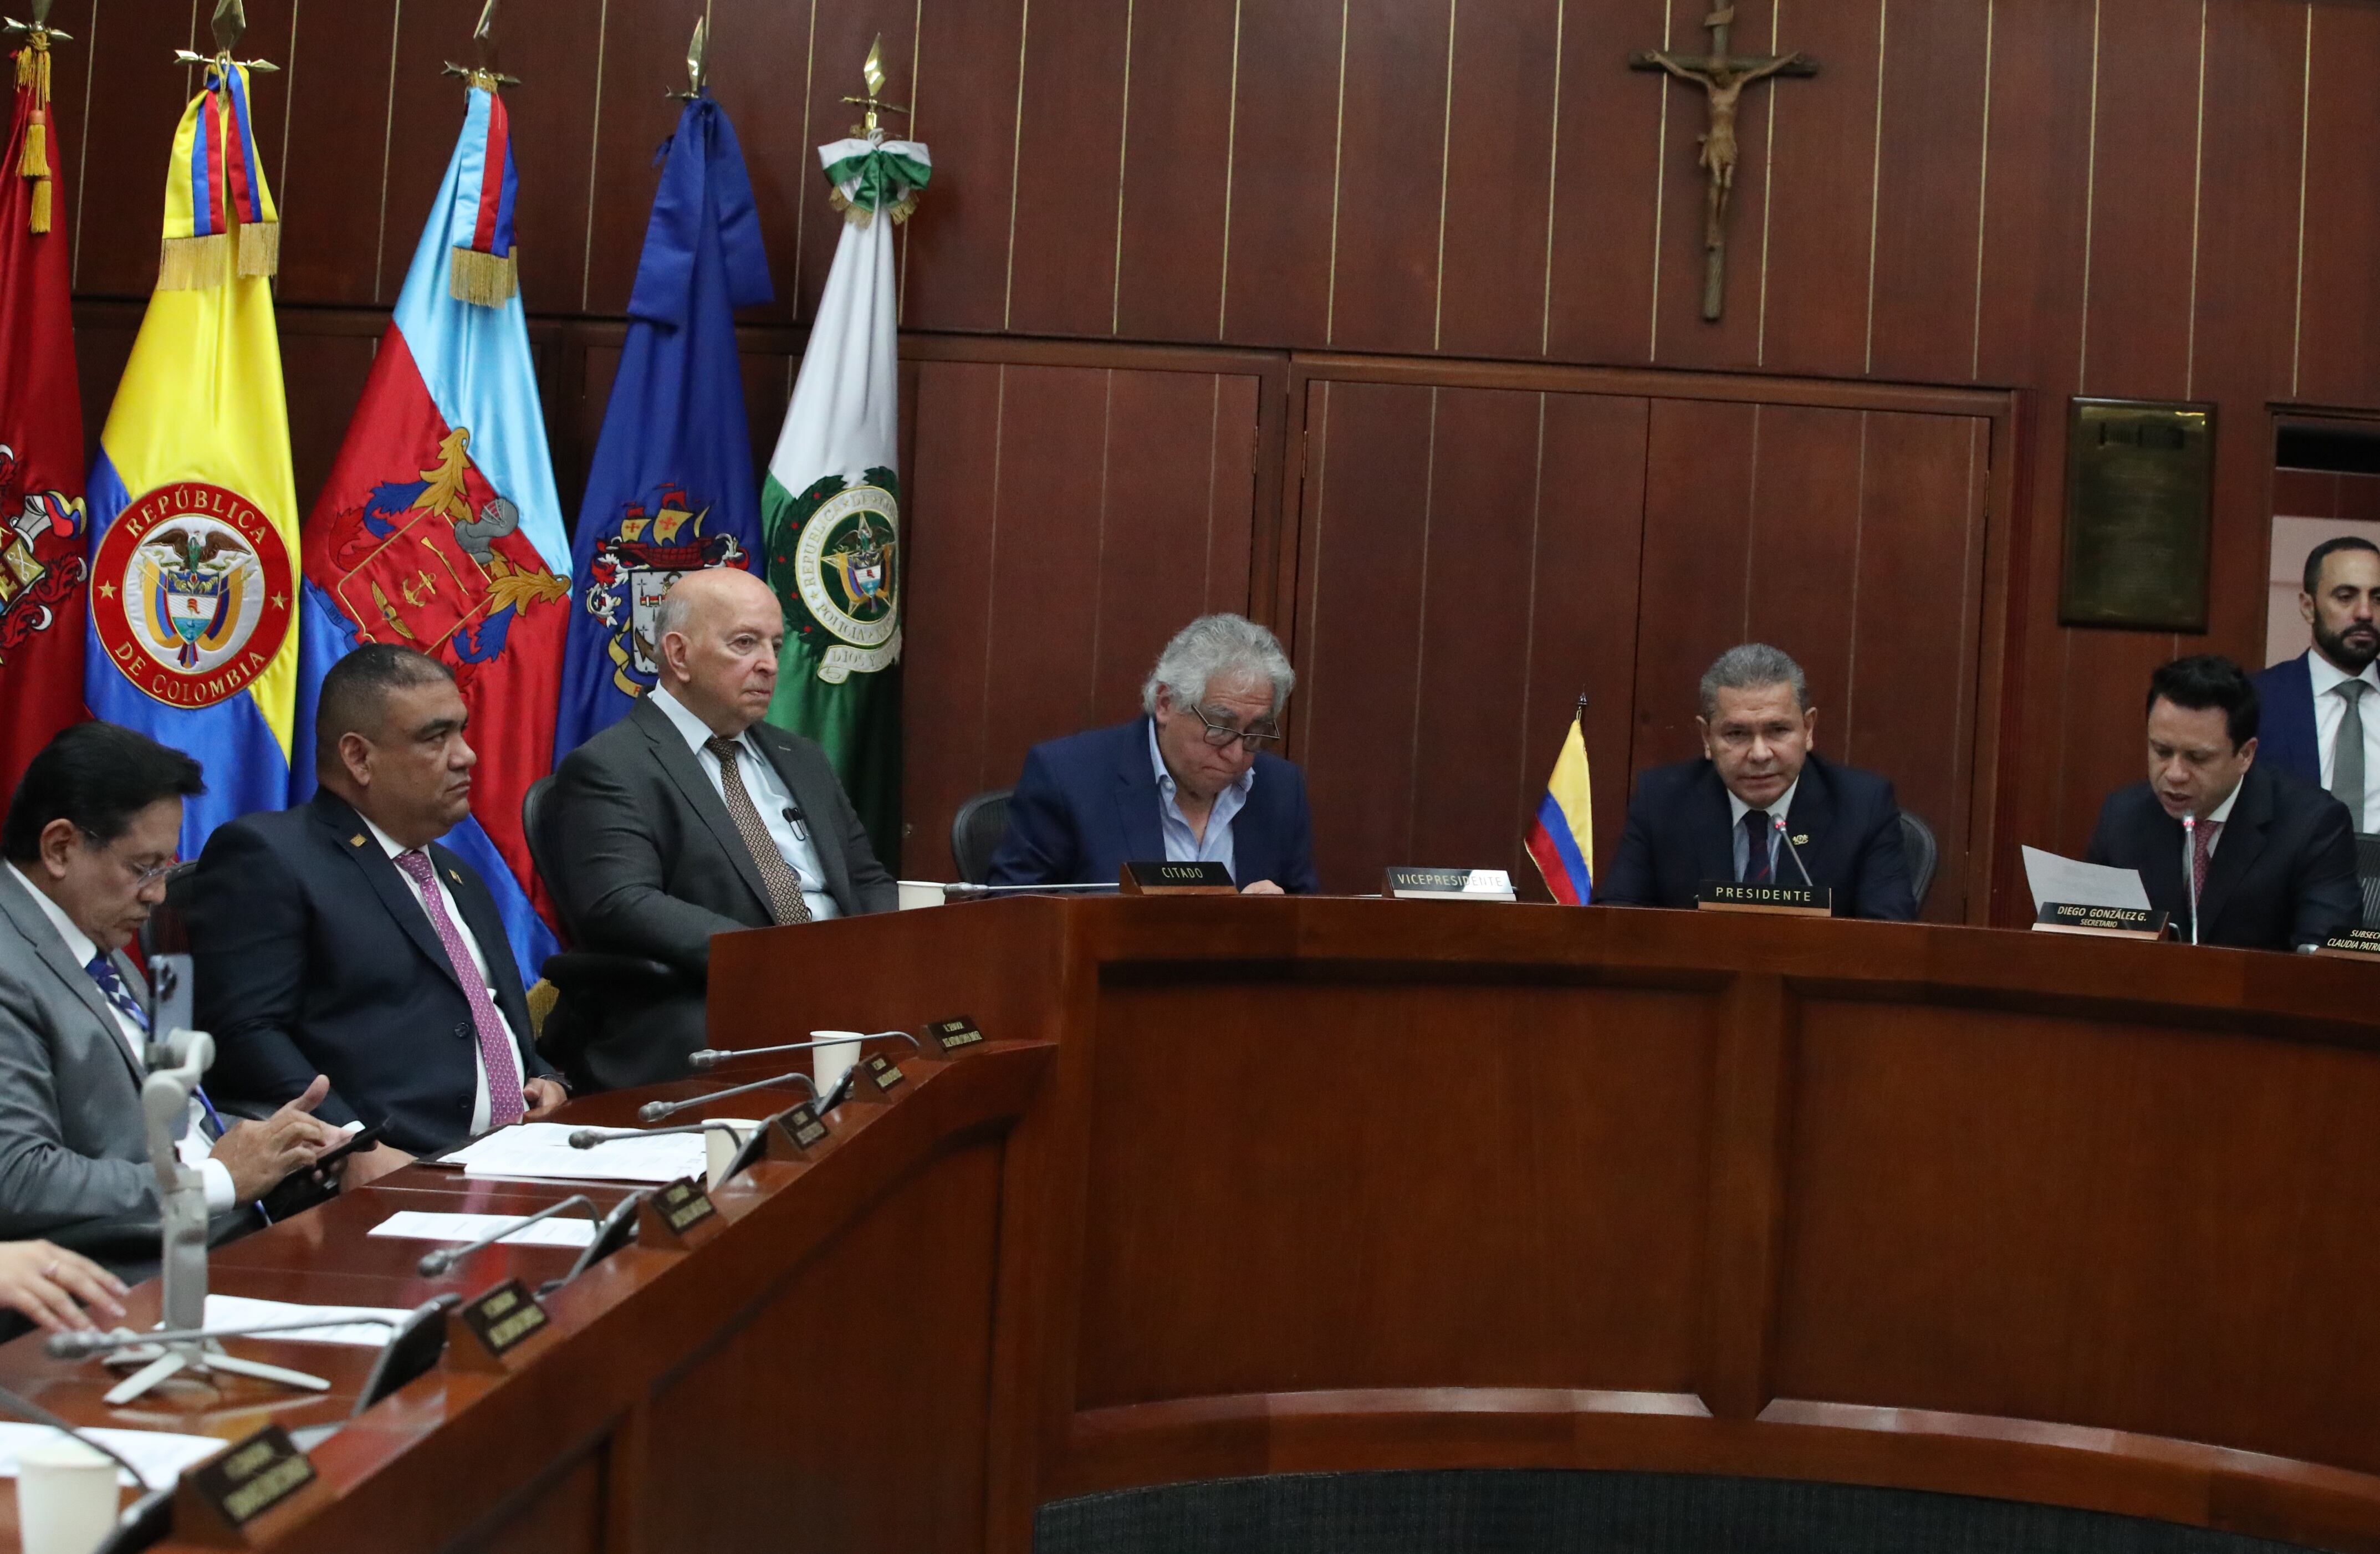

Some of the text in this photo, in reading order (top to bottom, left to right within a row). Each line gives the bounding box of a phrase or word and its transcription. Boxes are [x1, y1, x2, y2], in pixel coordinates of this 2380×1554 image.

[125, 485, 266, 544] REPÚBLICA
[833, 651, 865, 667] DIOS
[869, 655, 875, 667] Y
[115, 641, 266, 703] DE COLOMBIA
[1162, 867, 1203, 878] CITADO
[1397, 873, 1503, 887] VICEPRESIDENTE
[1716, 887, 1811, 902] PRESIDENTE
[2057, 906, 2147, 921] DIEGO GONZÁLEZ G.
[2080, 918, 2118, 928] SECRETARIO
[2327, 938, 2359, 949] CLAUDIA
